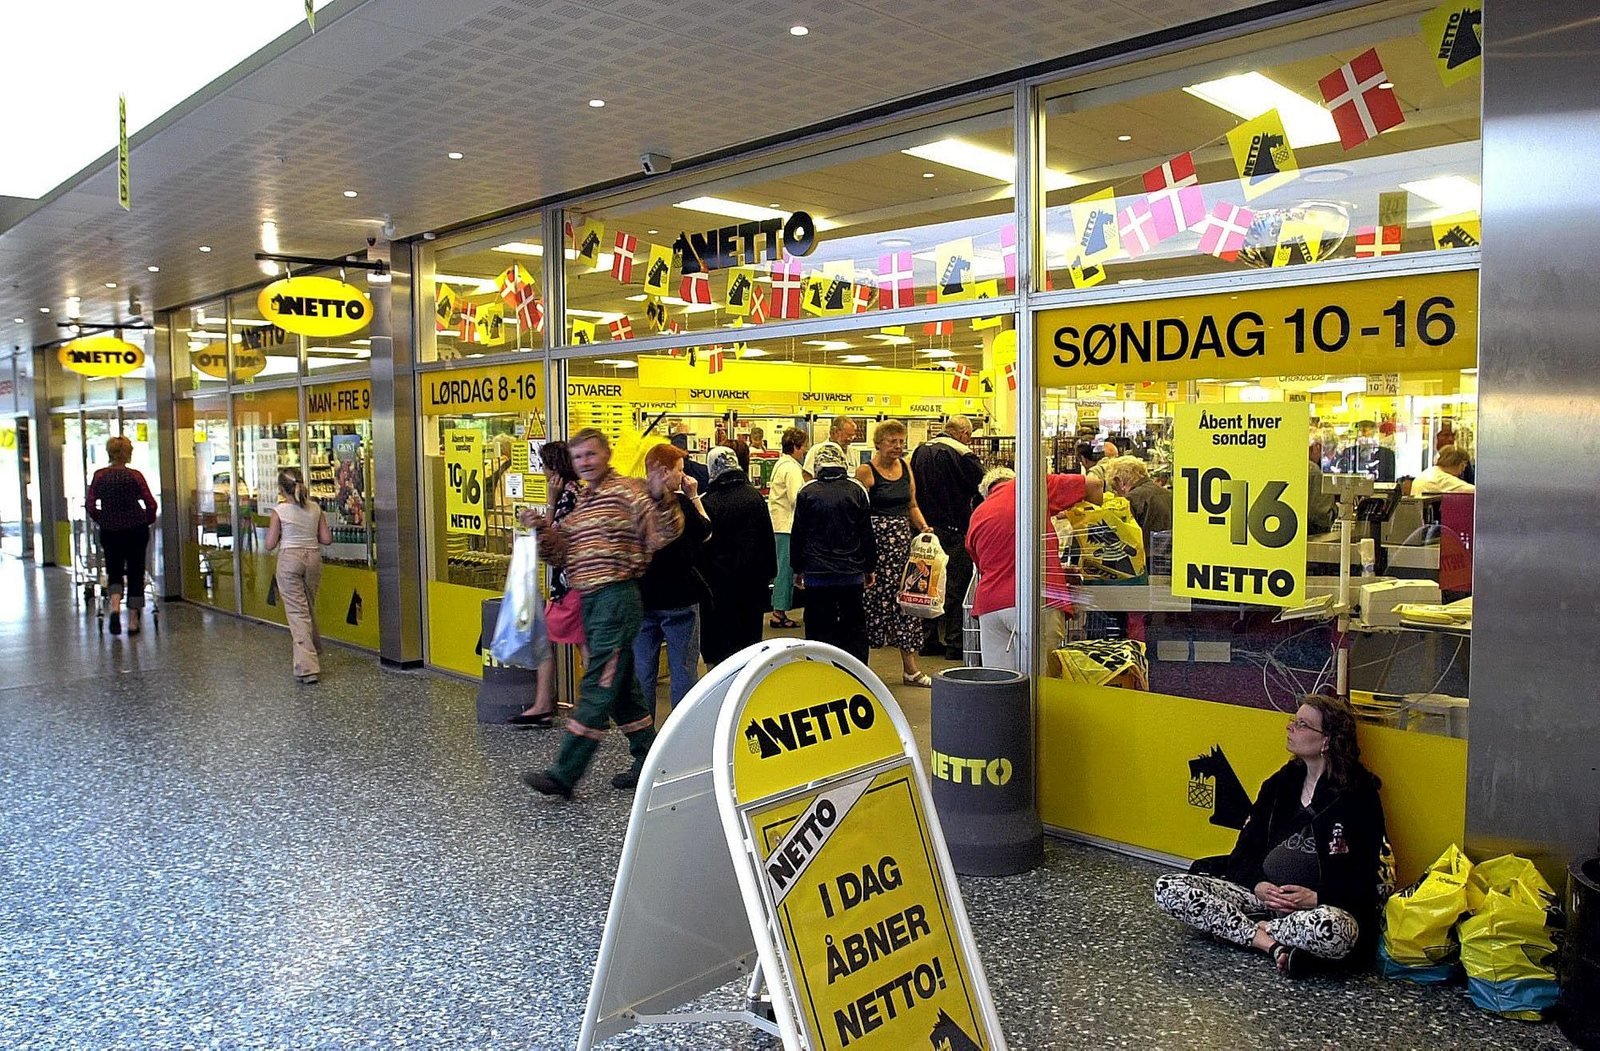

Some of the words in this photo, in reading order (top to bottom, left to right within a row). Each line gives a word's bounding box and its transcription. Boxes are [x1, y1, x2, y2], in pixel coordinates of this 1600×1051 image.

[1438, 11, 1460, 60] NETTO
[1243, 134, 1261, 177] NETTO
[678, 210, 817, 274] NETTO
[1080, 210, 1099, 247] NETTO
[940, 255, 958, 286] NETTO
[277, 293, 365, 320] NETTO
[1052, 310, 1266, 368] SØNDAG
[1284, 296, 1457, 355] 10-16
[69, 349, 136, 365] NETTO
[362, 388, 370, 410] 9
[430, 378, 494, 405] LØRDAG
[498, 374, 537, 401] 8-16
[1199, 409, 1242, 430] Åbent
[1247, 413, 1283, 430] hver
[1212, 430, 1267, 448] søndag
[450, 513, 481, 530] NETTO
[1186, 563, 1296, 598] NETTO
[758, 693, 876, 759] NETTO
[768, 798, 838, 891] NETTO
[818, 882, 835, 919] I
[836, 855, 904, 910] DAG
[824, 903, 932, 985] ÅBNER
[833, 956, 948, 1048] NETTO!
